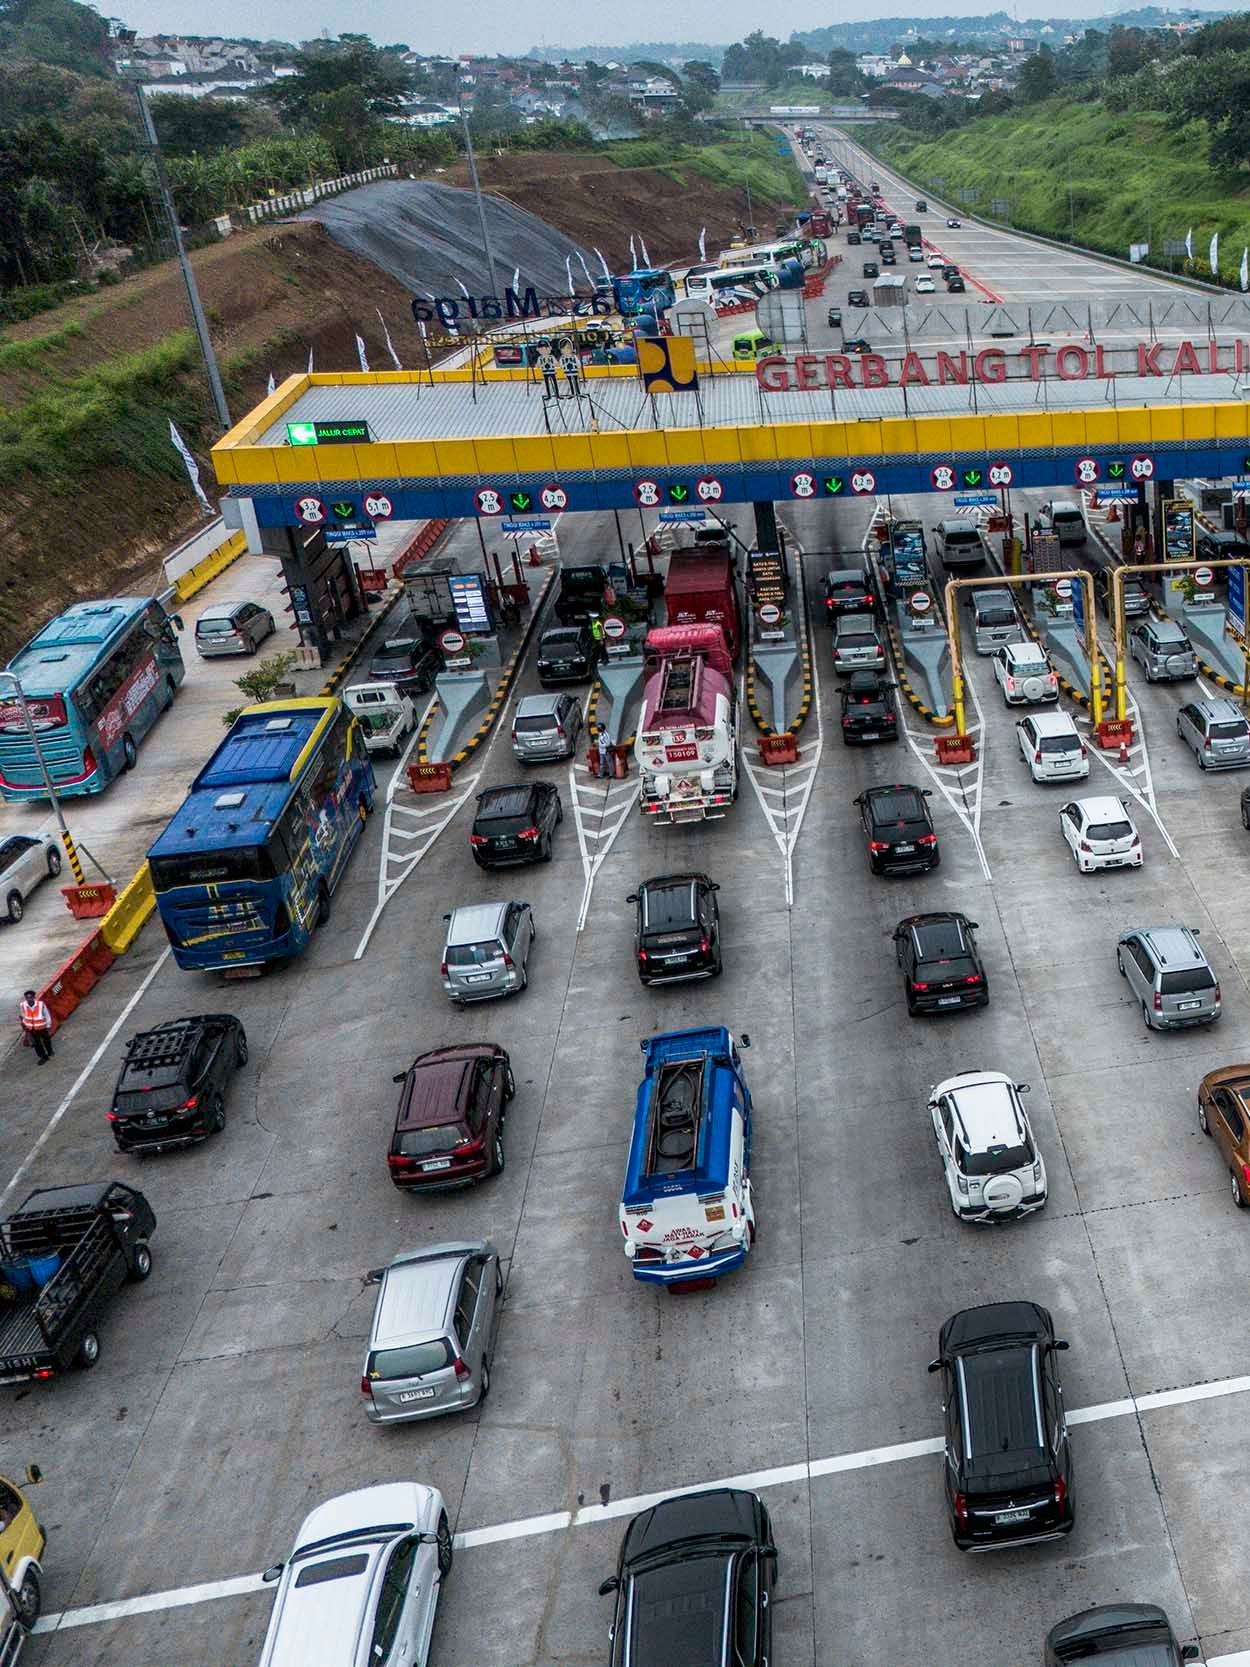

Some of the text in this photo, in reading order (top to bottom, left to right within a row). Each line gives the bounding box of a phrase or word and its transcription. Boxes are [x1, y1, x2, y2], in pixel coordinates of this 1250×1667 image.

[756, 347, 1007, 392] GERBANG
[1020, 344, 1118, 381] TOL
[318, 428, 365, 436] JALUR CEPAT
[669, 750, 696, 758] 150109
